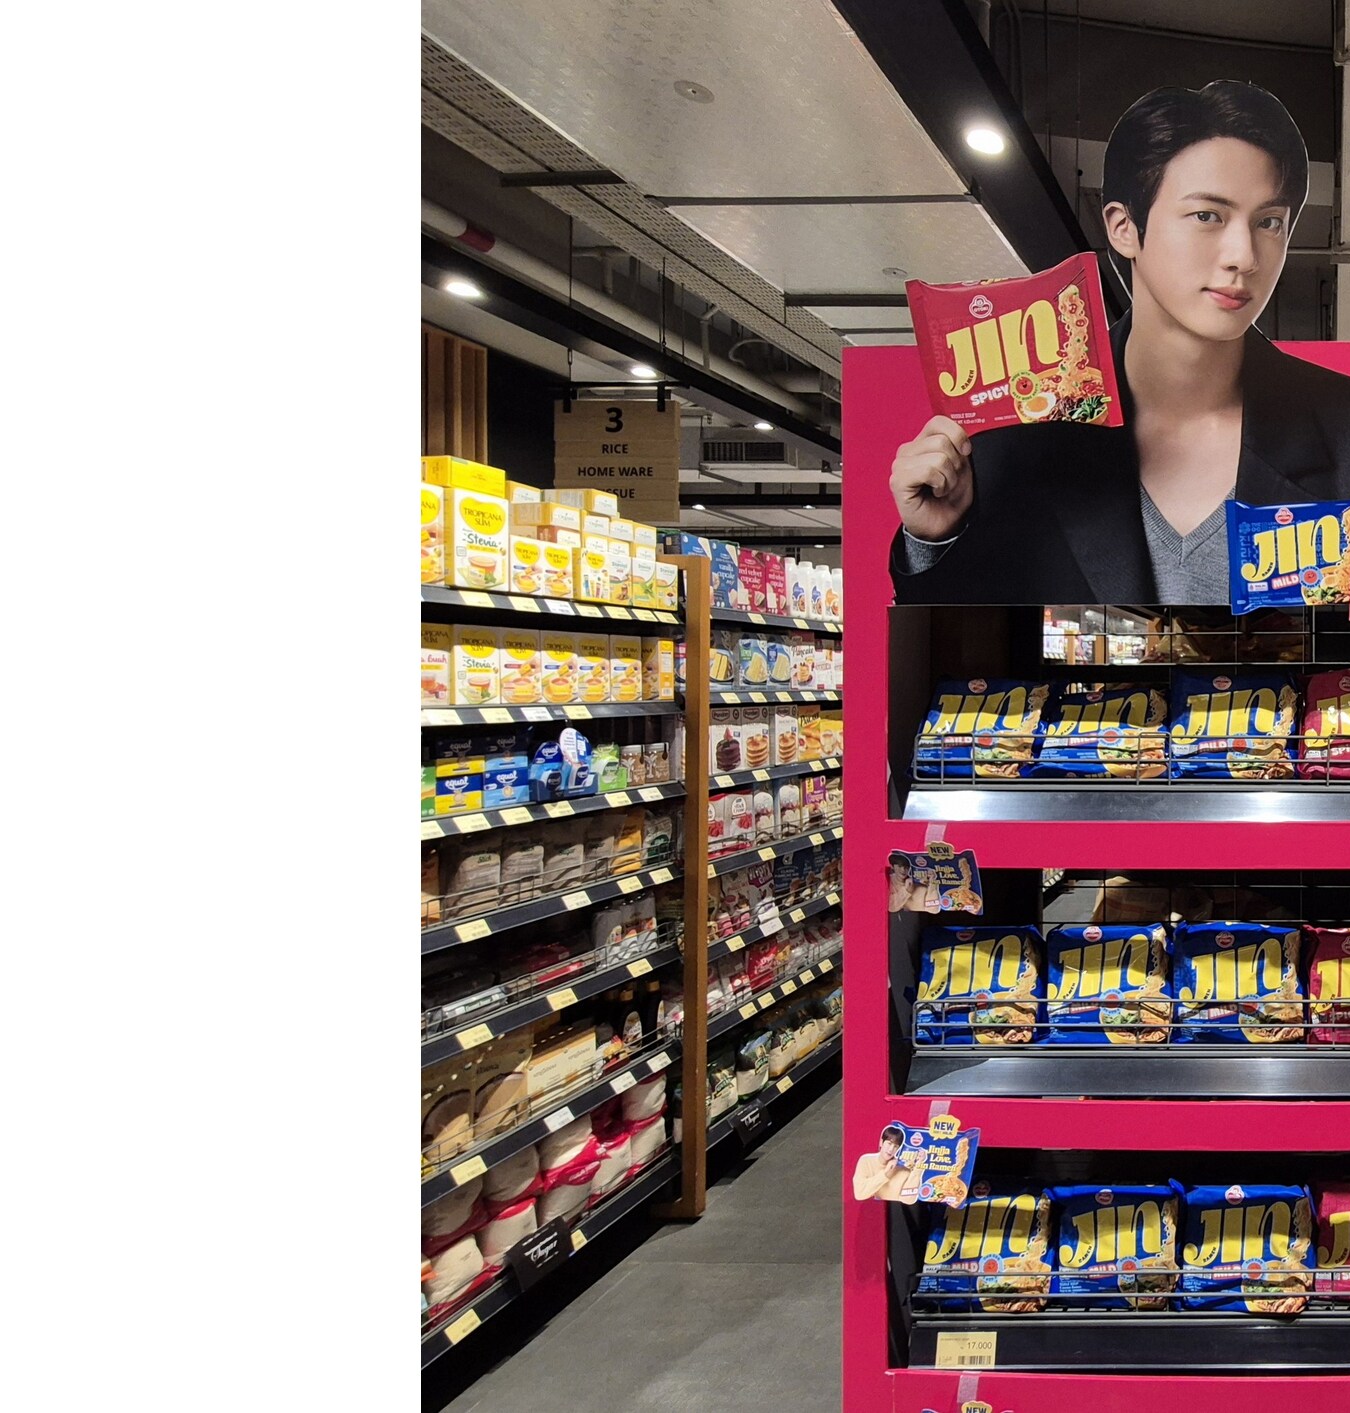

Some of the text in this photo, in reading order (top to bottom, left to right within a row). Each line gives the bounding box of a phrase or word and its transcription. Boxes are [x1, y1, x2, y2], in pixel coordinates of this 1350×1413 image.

[970, 384, 1010, 407] SPICY
[605, 407, 624, 433] 3
[602, 444, 628, 454] RICE
[578, 467, 653, 477] HOME WARE
[464, 508, 502, 521] TROPICANA
[475, 518, 490, 527] SLIM
[467, 533, 498, 548] Stevia
[1272, 574, 1299, 589] MILD
[462, 638, 493, 646] TROPICANA
[466, 659, 492, 669] Stevia
[542, 746, 559, 757] equal
[496, 770, 518, 783] equal
[445, 776, 469, 790] equal
[930, 846, 950, 854] NEW
[934, 1121, 955, 1131] NEW
[927, 1145, 950, 1155] Jinjja
[930, 1155, 951, 1164] Love.
